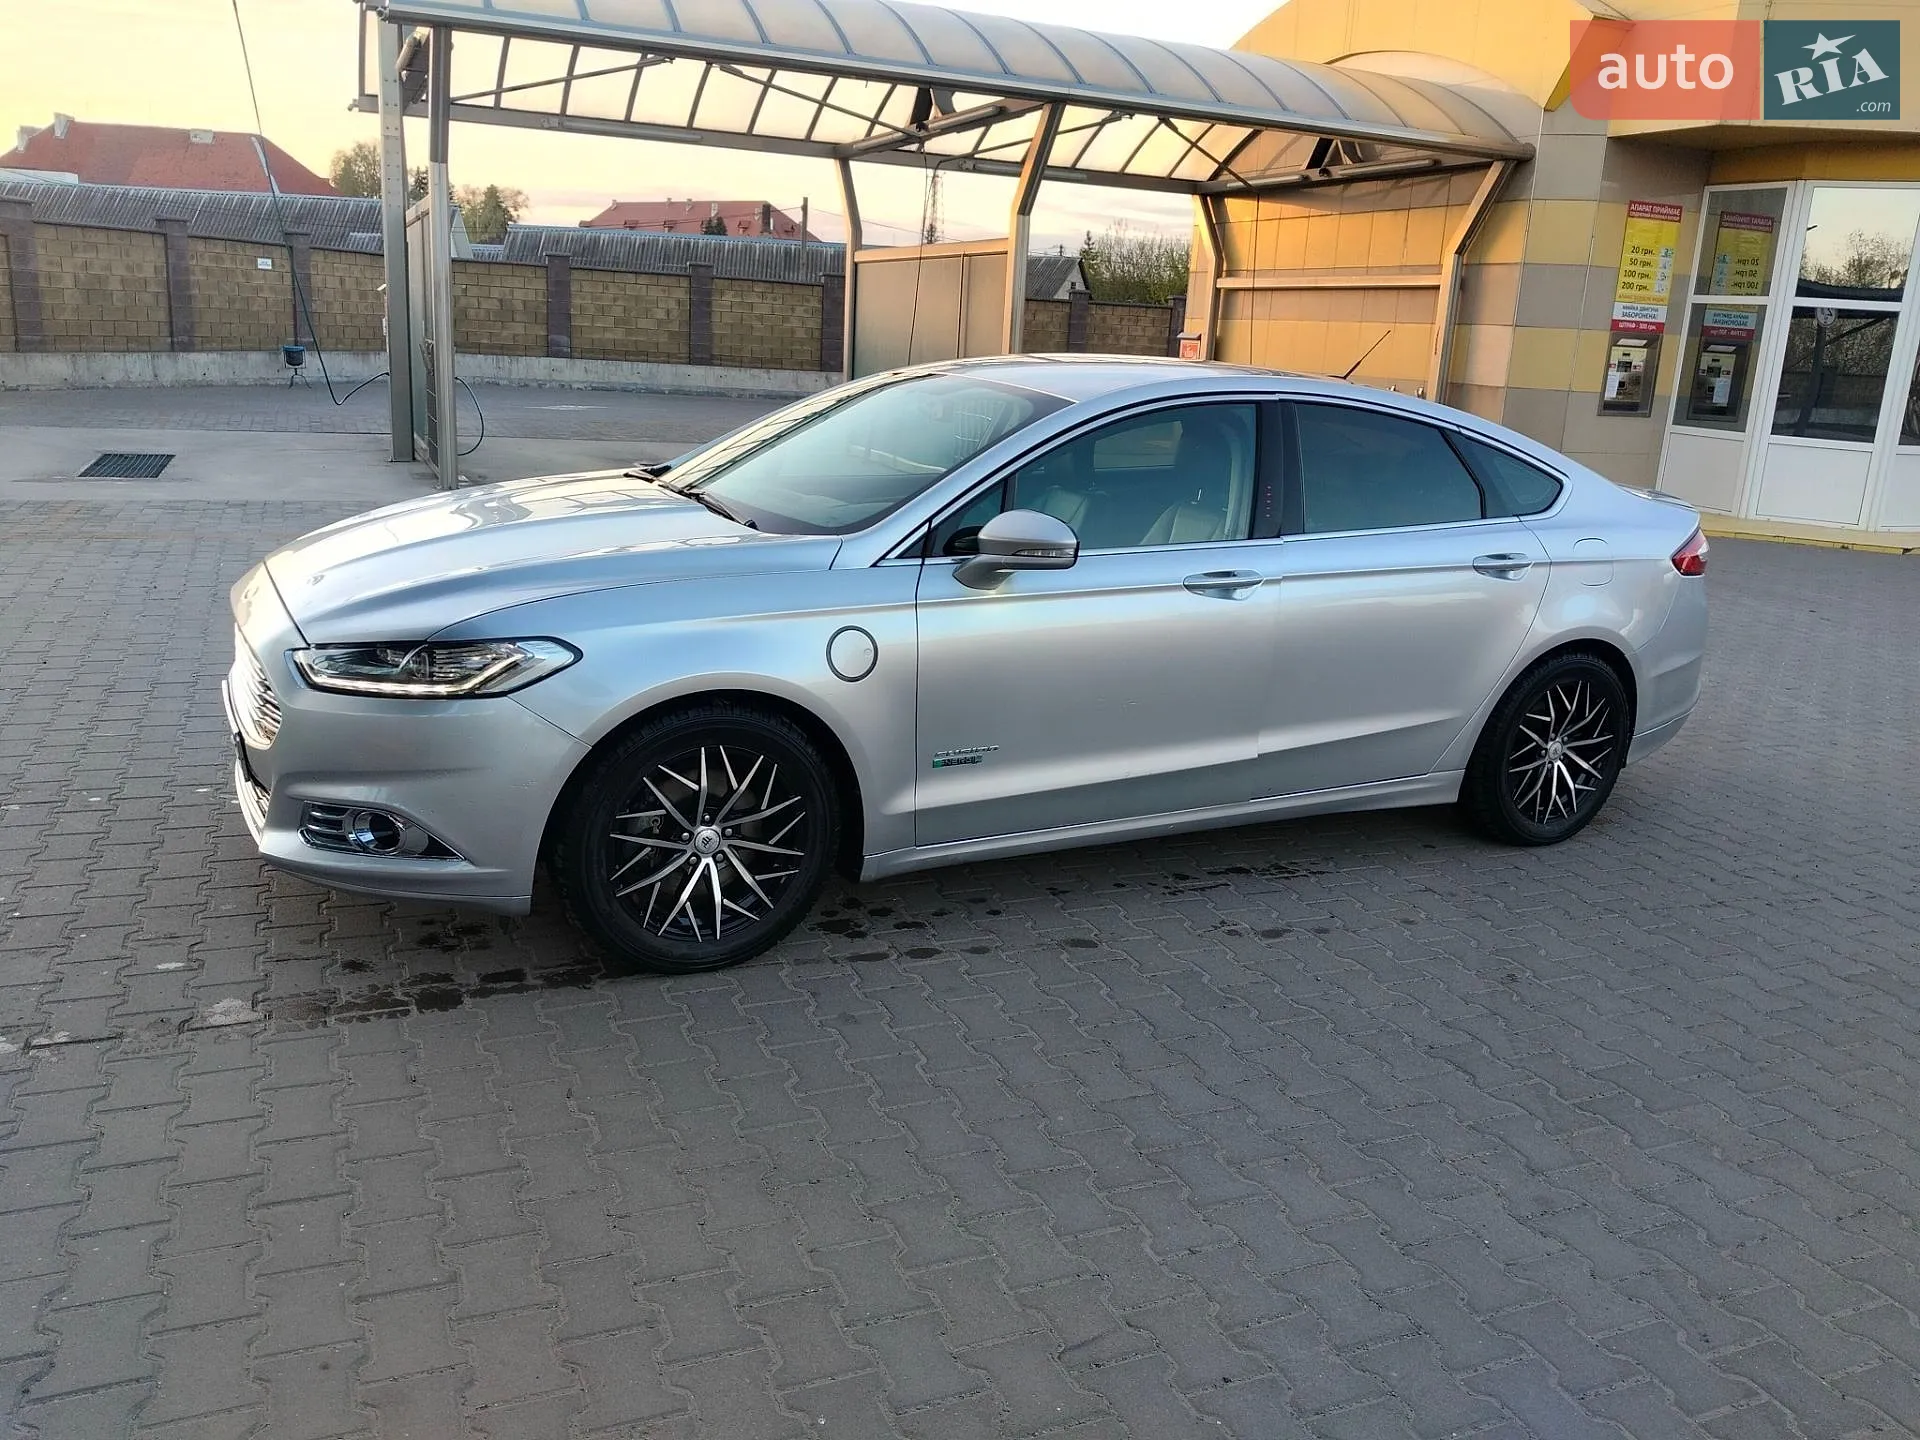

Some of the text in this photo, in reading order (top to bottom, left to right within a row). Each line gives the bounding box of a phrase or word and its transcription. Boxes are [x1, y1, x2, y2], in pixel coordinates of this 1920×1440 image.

[1630, 203, 1652, 212] АПАРАТ
[1653, 205, 1681, 217] ПРИЙМАЄ
[1630, 246, 1640, 254] 20
[1629, 257, 1638, 266] 50
[1624, 269, 1637, 278] 100
[1621, 281, 1634, 290] 200
